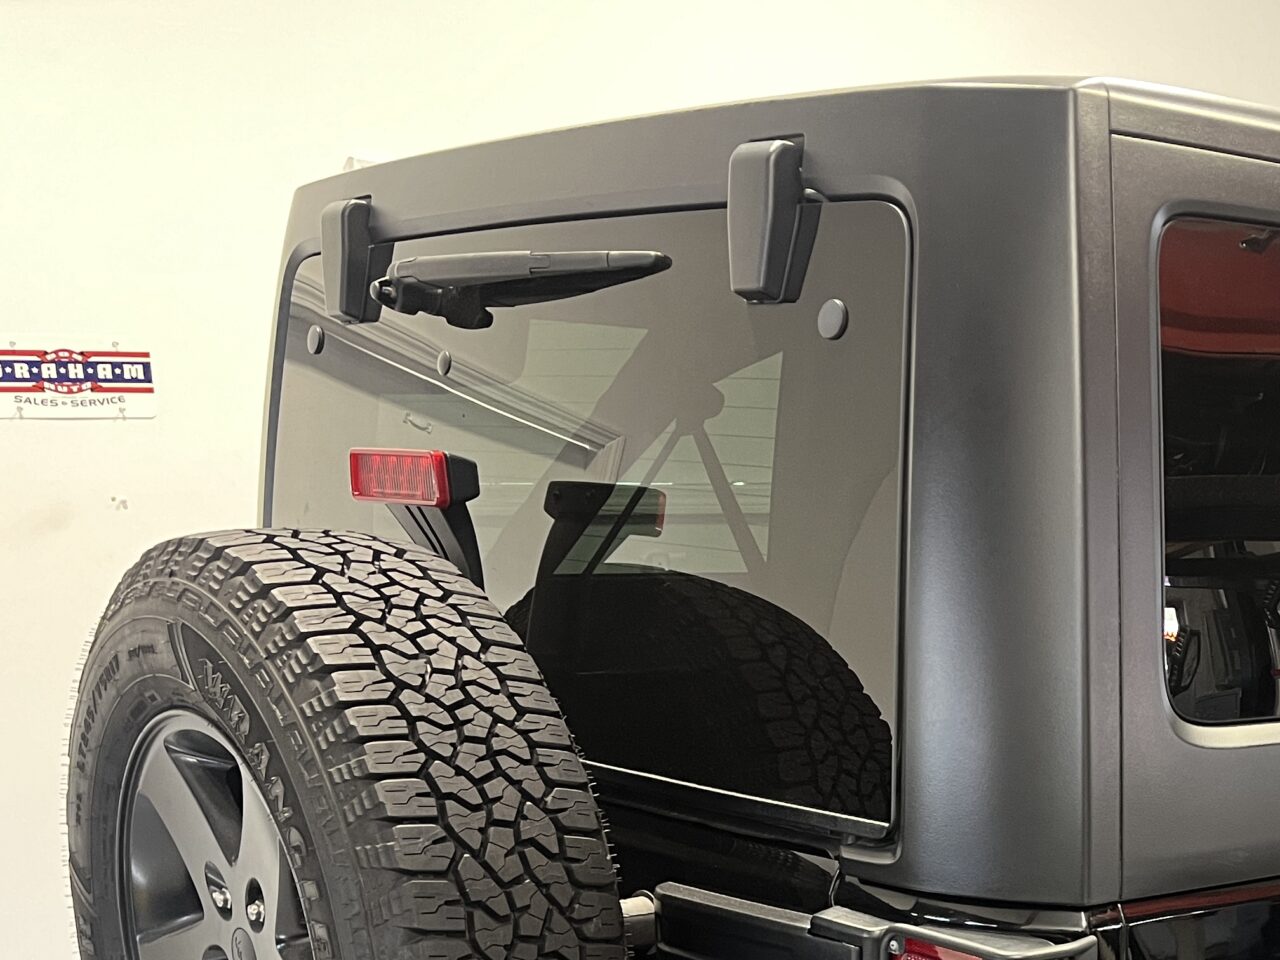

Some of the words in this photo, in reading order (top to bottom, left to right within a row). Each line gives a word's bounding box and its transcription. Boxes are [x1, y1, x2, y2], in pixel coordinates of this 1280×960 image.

[0, 362, 145, 380] RAHAM
[14, 395, 58, 407] SALES
[70, 395, 126, 407] SERVICE
